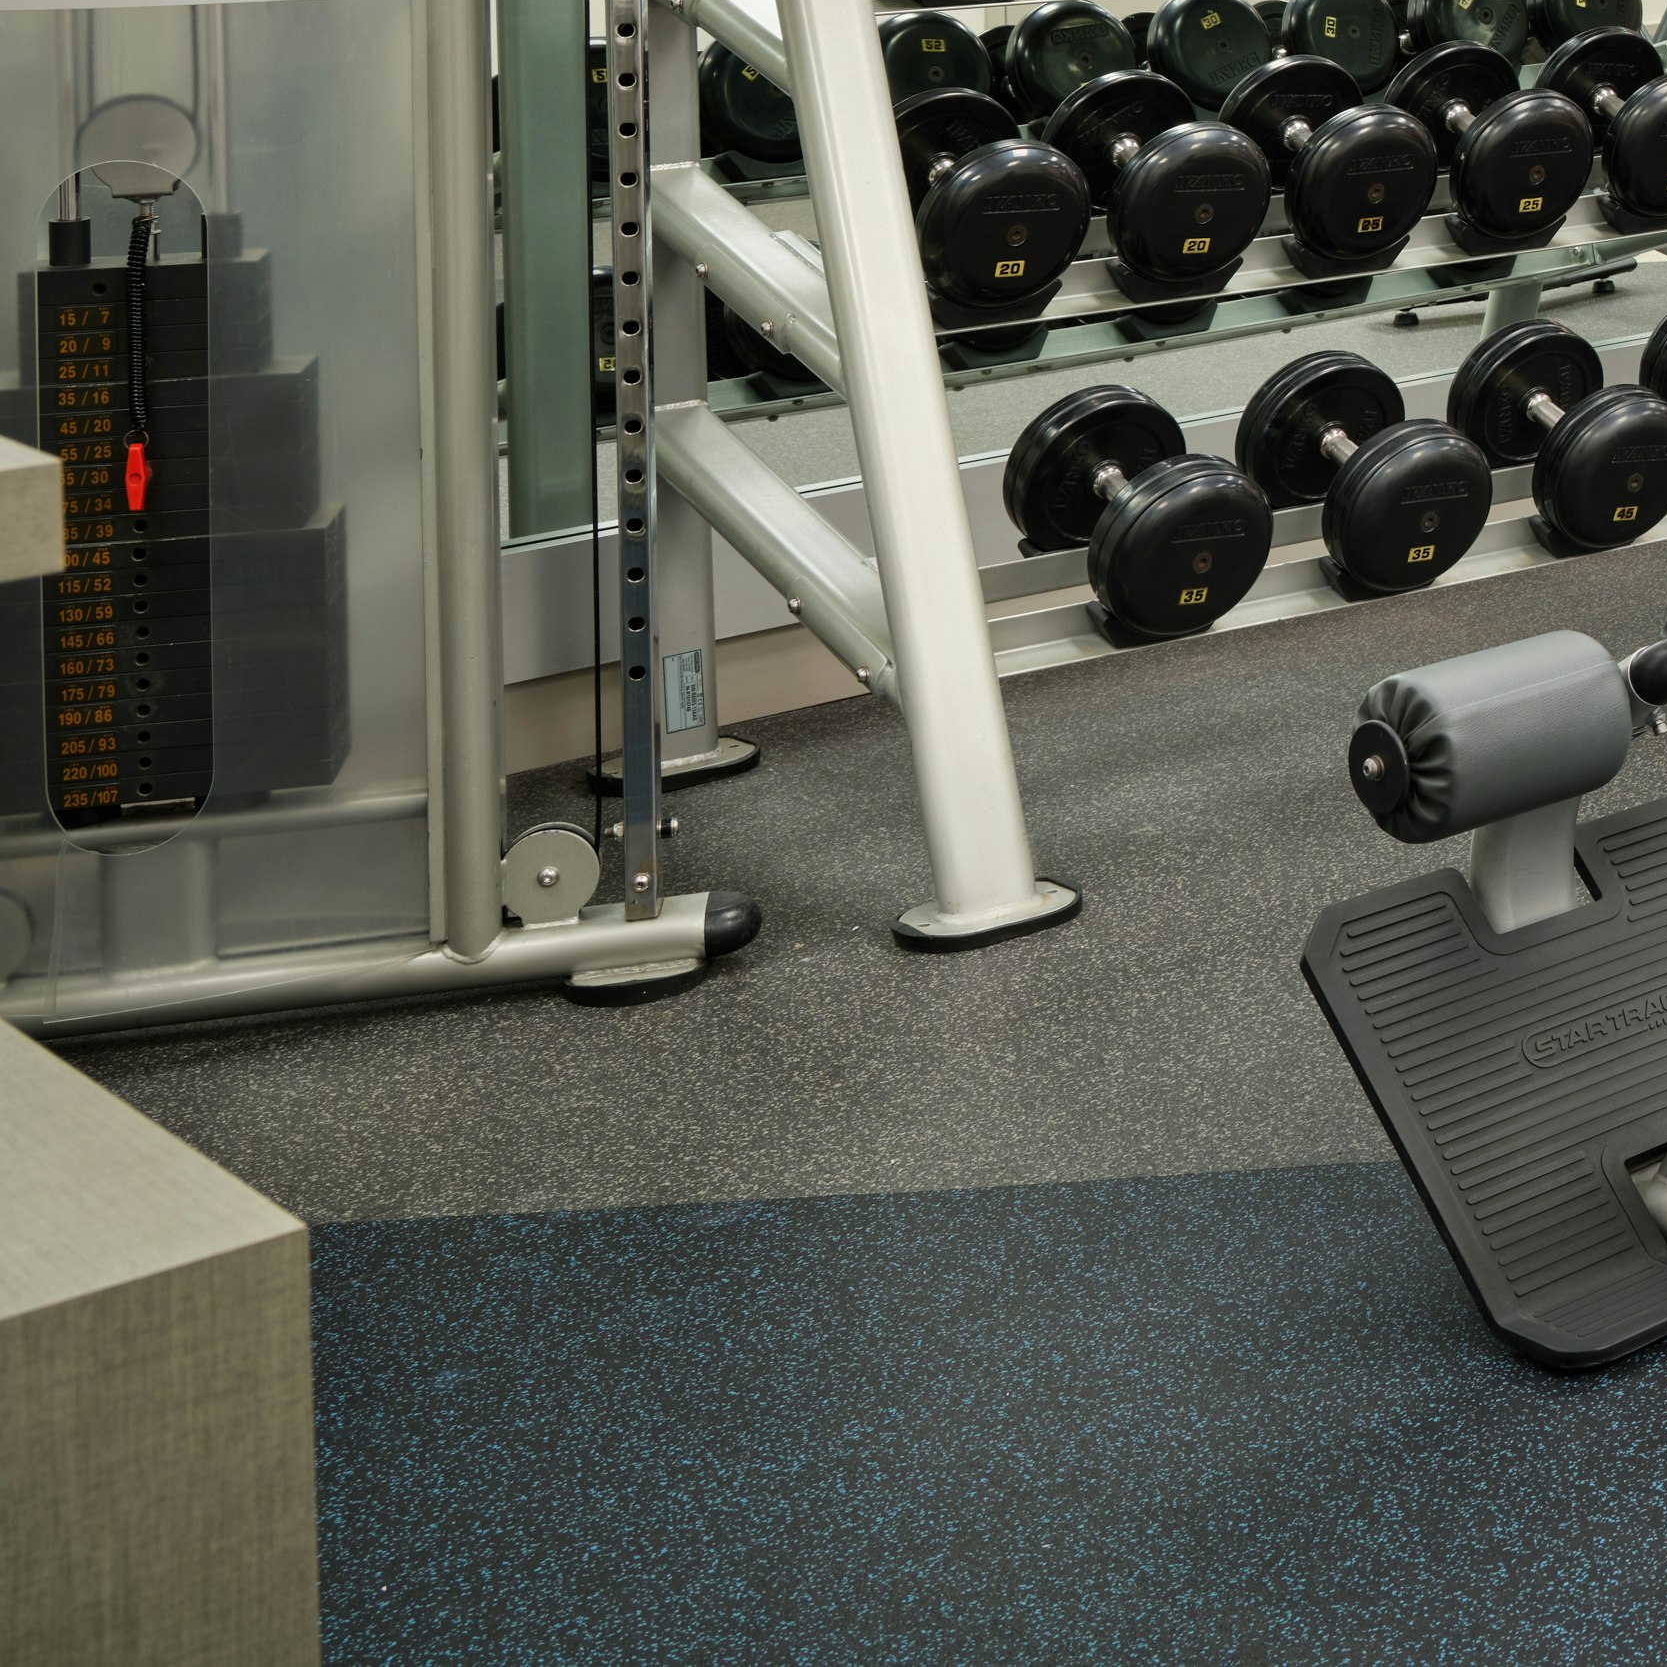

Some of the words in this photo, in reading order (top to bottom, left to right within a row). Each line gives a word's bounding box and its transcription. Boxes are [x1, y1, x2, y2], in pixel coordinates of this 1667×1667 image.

[1522, 199, 1540, 211] 25
[1361, 219, 1380, 231] 25
[1187, 240, 1207, 252] 20
[1000, 262, 1023, 276] 20
[60, 314, 76, 326] 15
[101, 311, 110, 324] 7
[60, 340, 77, 353] 20
[102, 337, 111, 350] 9
[59, 366, 76, 378] 25
[93, 364, 109, 377] 11
[58, 393, 75, 405] 35
[92, 391, 109, 404] 16
[60, 422, 77, 434] 45
[94, 419, 111, 432] 20
[61, 448, 78, 461] 55
[94, 446, 112, 458] 25
[91, 471, 108, 484] 30
[95, 498, 112, 511] 34
[1617, 508, 1634, 520] 45
[96, 524, 113, 538] 39
[92, 551, 110, 565] 45
[1411, 547, 1432, 560] 35
[58, 580, 80, 593] 115
[94, 578, 111, 591] 52
[1183, 590, 1206, 603] 35
[59, 609, 83, 622] 130
[95, 606, 113, 619] 59
[60, 635, 83, 648] 145
[96, 632, 114, 645] 66
[60, 661, 84, 675] 160
[96, 658, 114, 671] 73
[62, 688, 84, 701] 175
[98, 684, 115, 698] 79
[58, 712, 82, 725] 190
[95, 709, 112, 723] 86
[62, 740, 86, 754] 205
[98, 737, 116, 751] 93
[63, 766, 87, 780] 220
[97, 763, 118, 777] 100
[64, 794, 88, 807] 235
[97, 790, 118, 804] 107
